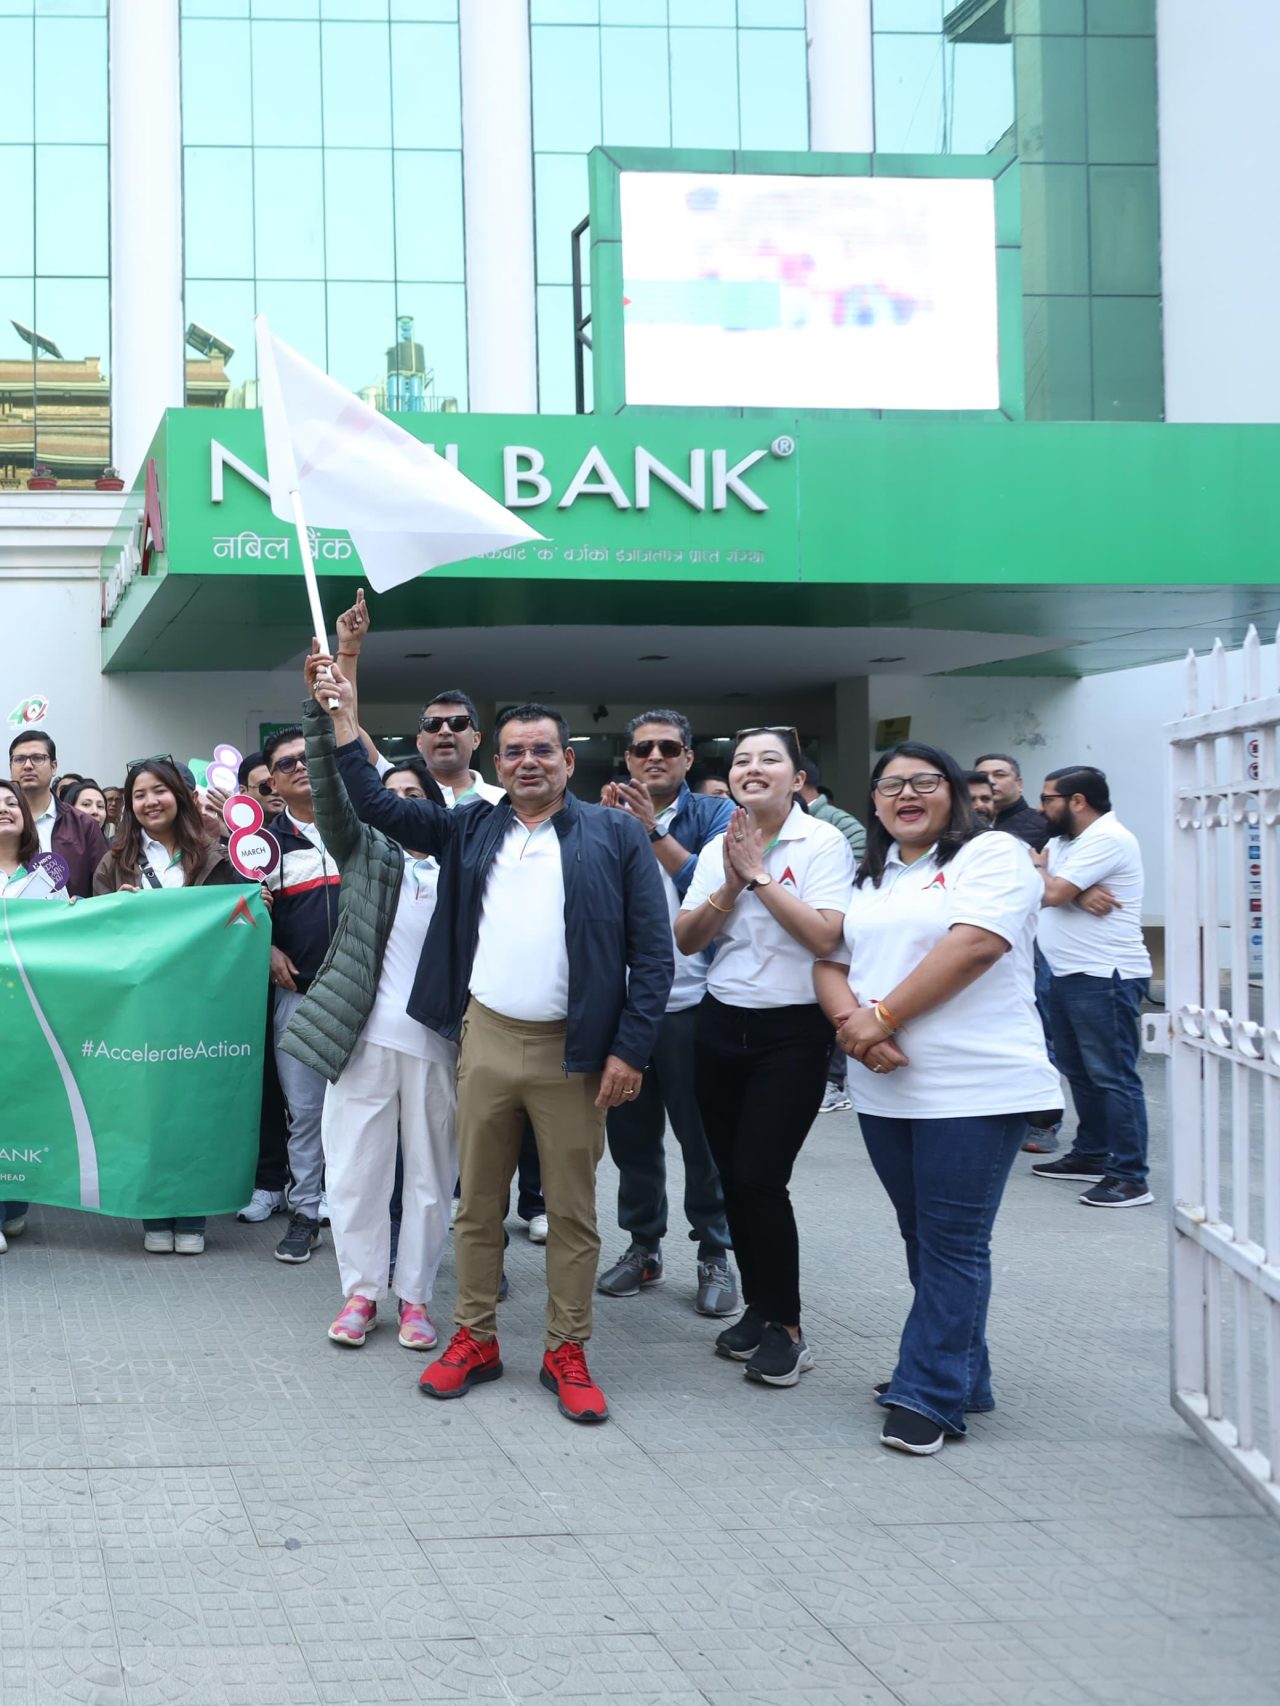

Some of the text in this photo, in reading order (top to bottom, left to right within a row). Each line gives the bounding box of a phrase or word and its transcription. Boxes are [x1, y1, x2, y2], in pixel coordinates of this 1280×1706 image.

[212, 531, 291, 560] नबिल
[241, 846, 266, 858] MARCH
[81, 1040, 251, 1062] #AccelerateAction
